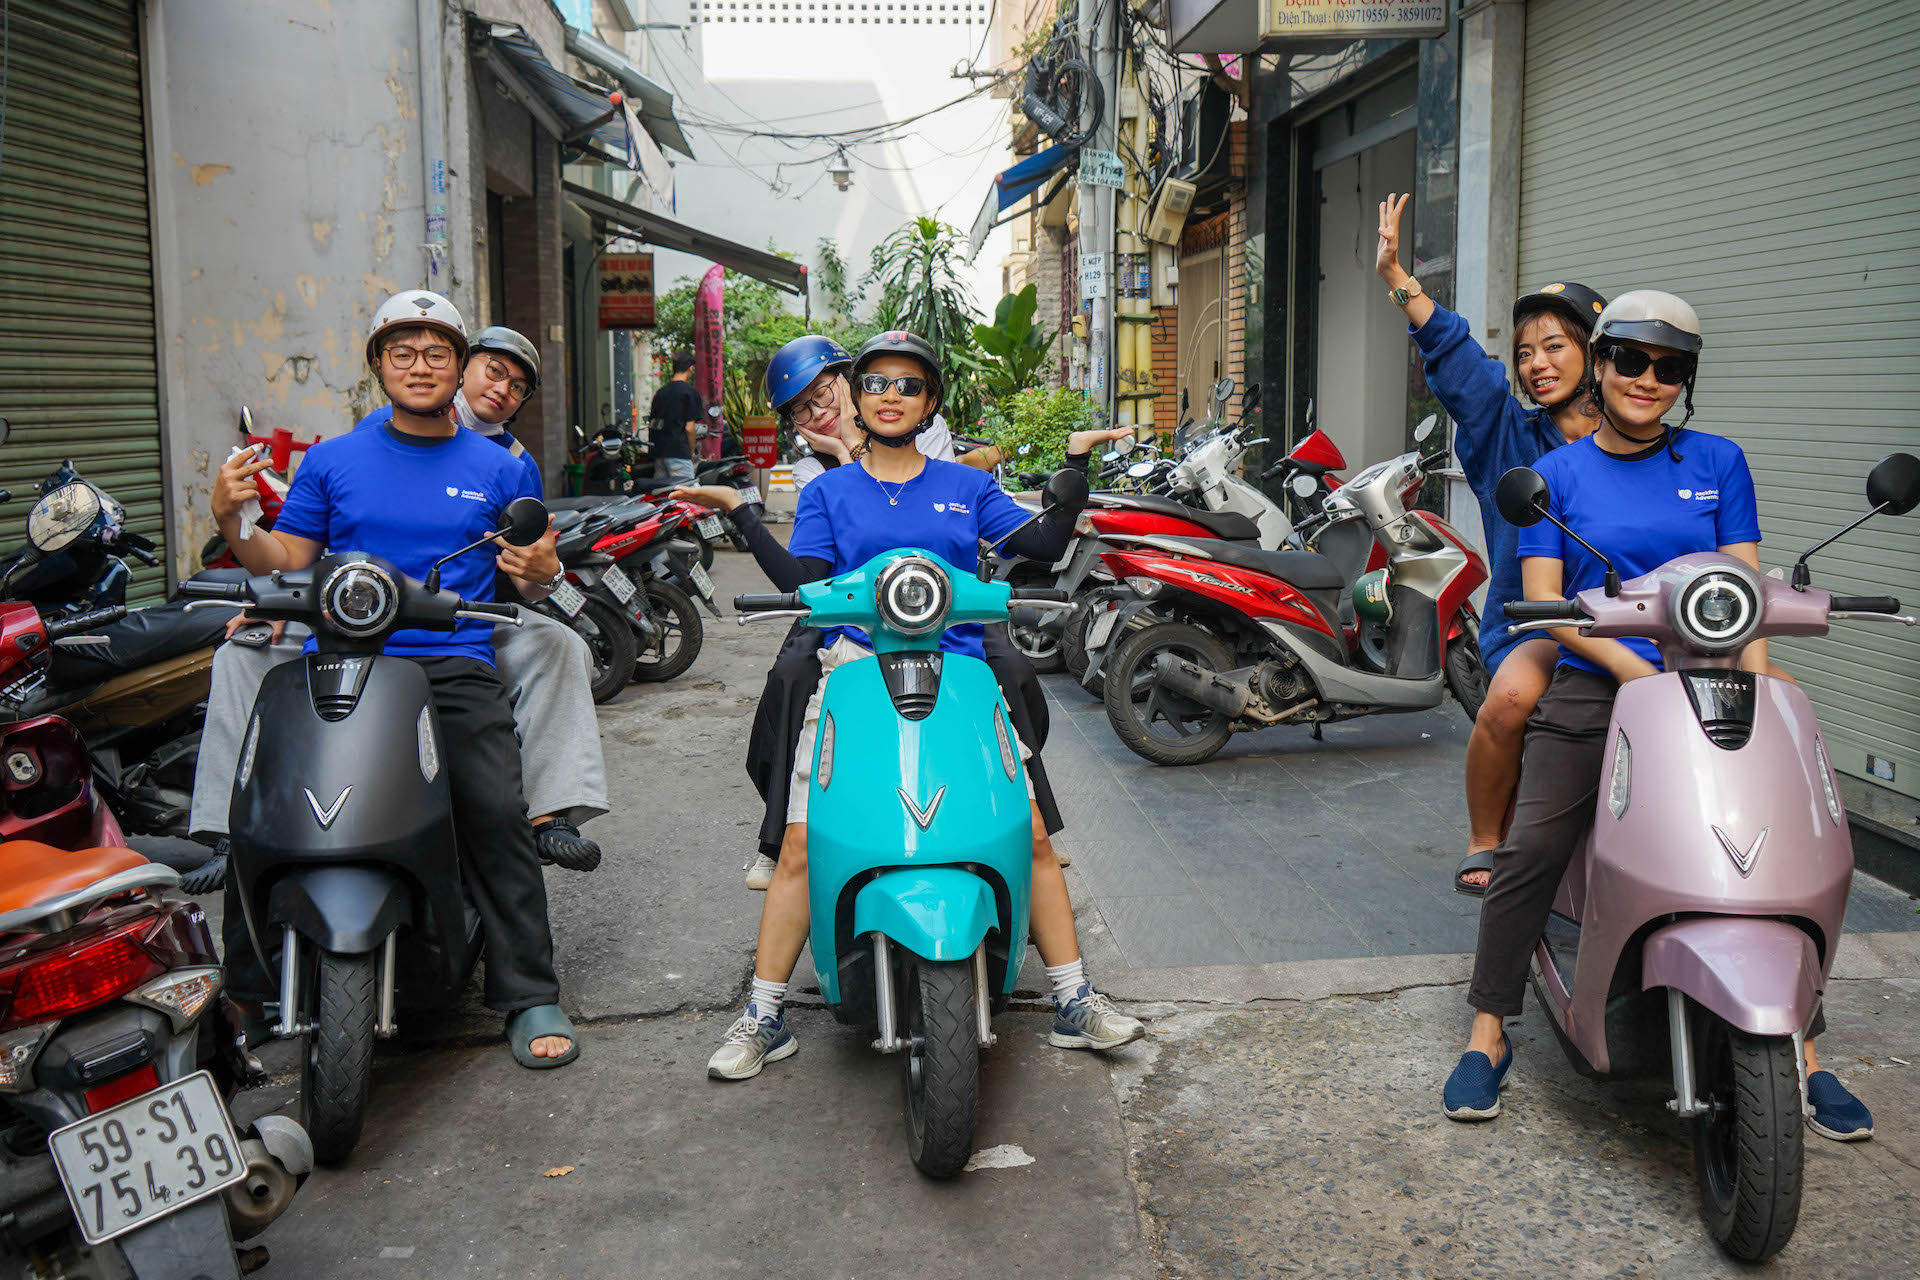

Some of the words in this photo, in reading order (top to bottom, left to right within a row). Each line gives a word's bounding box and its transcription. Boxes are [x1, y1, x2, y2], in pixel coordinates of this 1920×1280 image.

[1278, 10, 1299, 27] Điện
[1301, 10, 1327, 27] Thoại
[1333, 9, 1389, 23] 0939719559
[1397, 7, 1442, 22] 38591072
[744, 435, 758, 444] CHO
[747, 445, 757, 454] XE
[316, 662, 362, 671] VINFAST
[890, 662, 935, 670] VINFAST
[1695, 682, 1748, 691] VINFAST
[77, 1090, 197, 1173] 59-S1
[81, 1133, 234, 1233] 754.39
